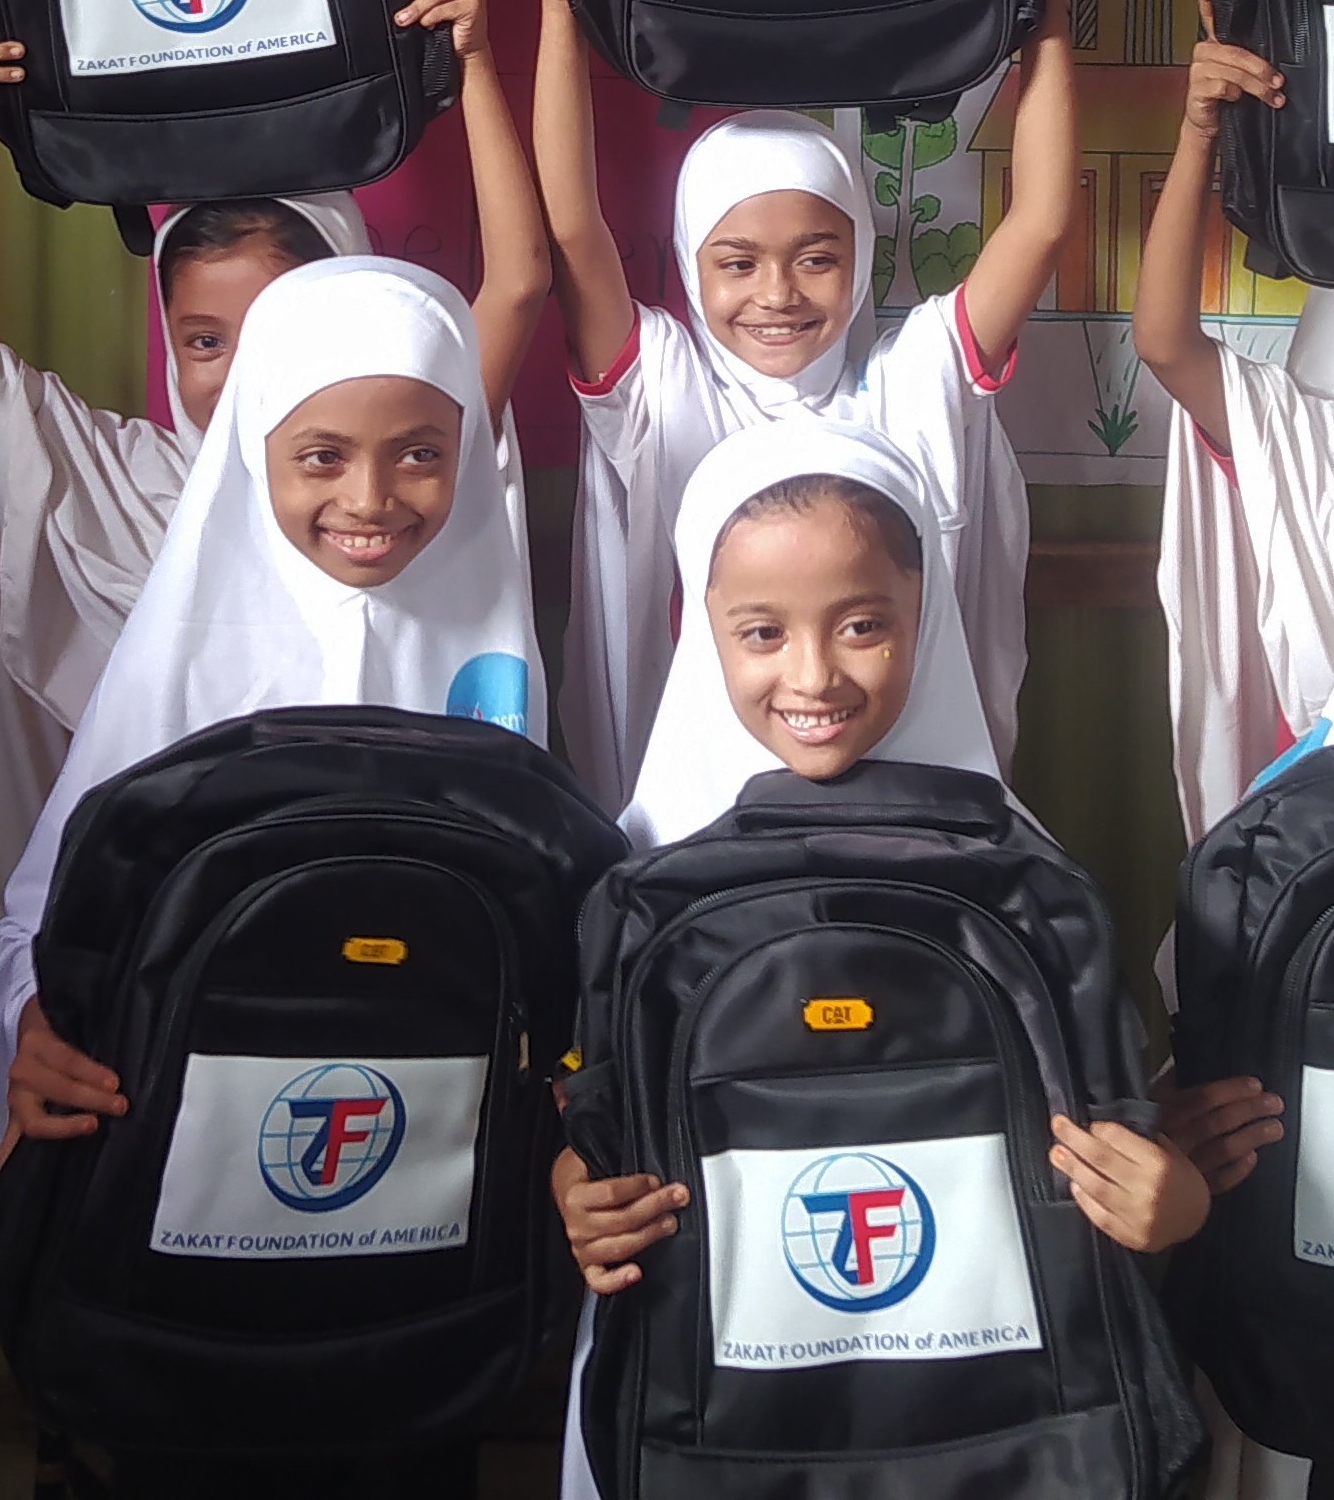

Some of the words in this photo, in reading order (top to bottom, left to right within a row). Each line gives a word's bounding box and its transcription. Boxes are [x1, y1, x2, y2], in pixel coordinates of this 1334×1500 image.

[77, 56, 126, 71] ZAKAT
[129, 44, 233, 67] FOUNDATION
[238, 41, 253, 54] of
[256, 31, 327, 51] AMERICA
[161, 1230, 224, 1248] ZAKAT
[228, 1231, 353, 1251] FOUNDATION
[358, 1230, 375, 1245] of
[380, 1223, 460, 1245] AMERICA
[724, 1341, 779, 1360] ZAKAT
[780, 1333, 910, 1358] FOUNDATION
[915, 1331, 934, 1347] of
[939, 1326, 1030, 1347] AMERICA
